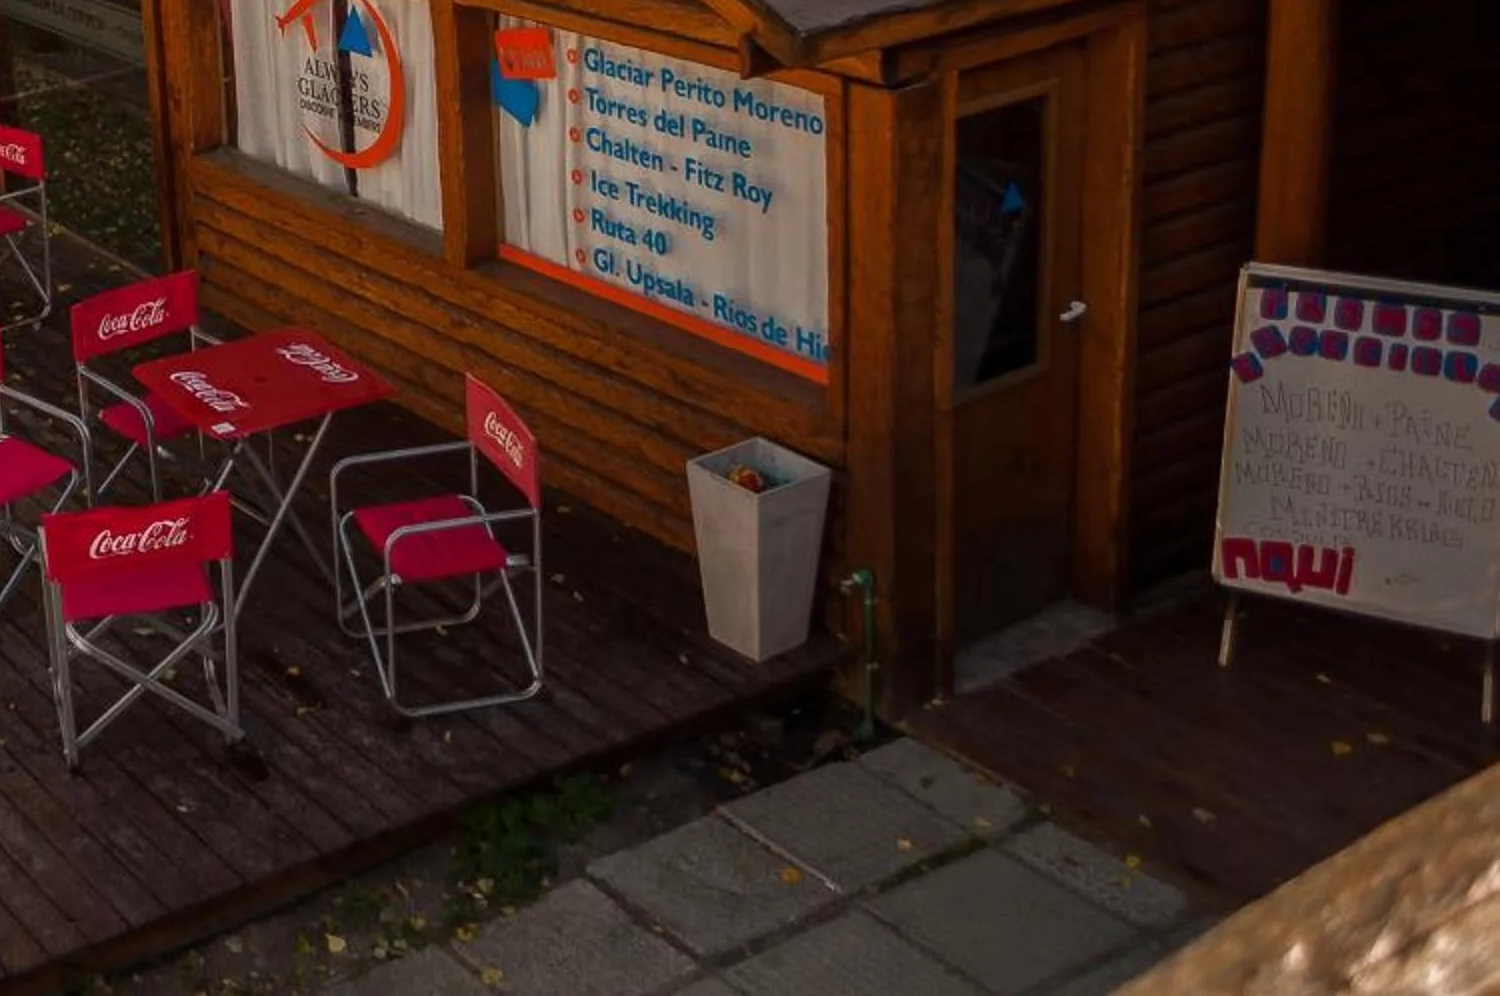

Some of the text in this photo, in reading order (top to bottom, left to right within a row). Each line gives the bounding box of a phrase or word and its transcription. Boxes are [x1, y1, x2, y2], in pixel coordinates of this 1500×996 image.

[298, 77, 381, 119] GLACERS
[584, 48, 654, 88] Glaciar
[661, 68, 725, 108] Perito
[733, 88, 824, 134] Moreno
[585, 87, 752, 158] Torres del Paine
[591, 170, 715, 242] Ice Trekking
[685, 157, 724, 192] Fitz
[731, 172, 773, 215] Roy
[591, 208, 668, 256] Ruta 40
[97, 299, 165, 340] Coca-Cola
[594, 248, 621, 276] Gl.
[626, 259, 695, 307] Upsala
[762, 316, 788, 346] de
[169, 371, 249, 412] Coca-Cola
[483, 411, 525, 469] Coca-Cola
[89, 517, 189, 559] Coca-Cola
